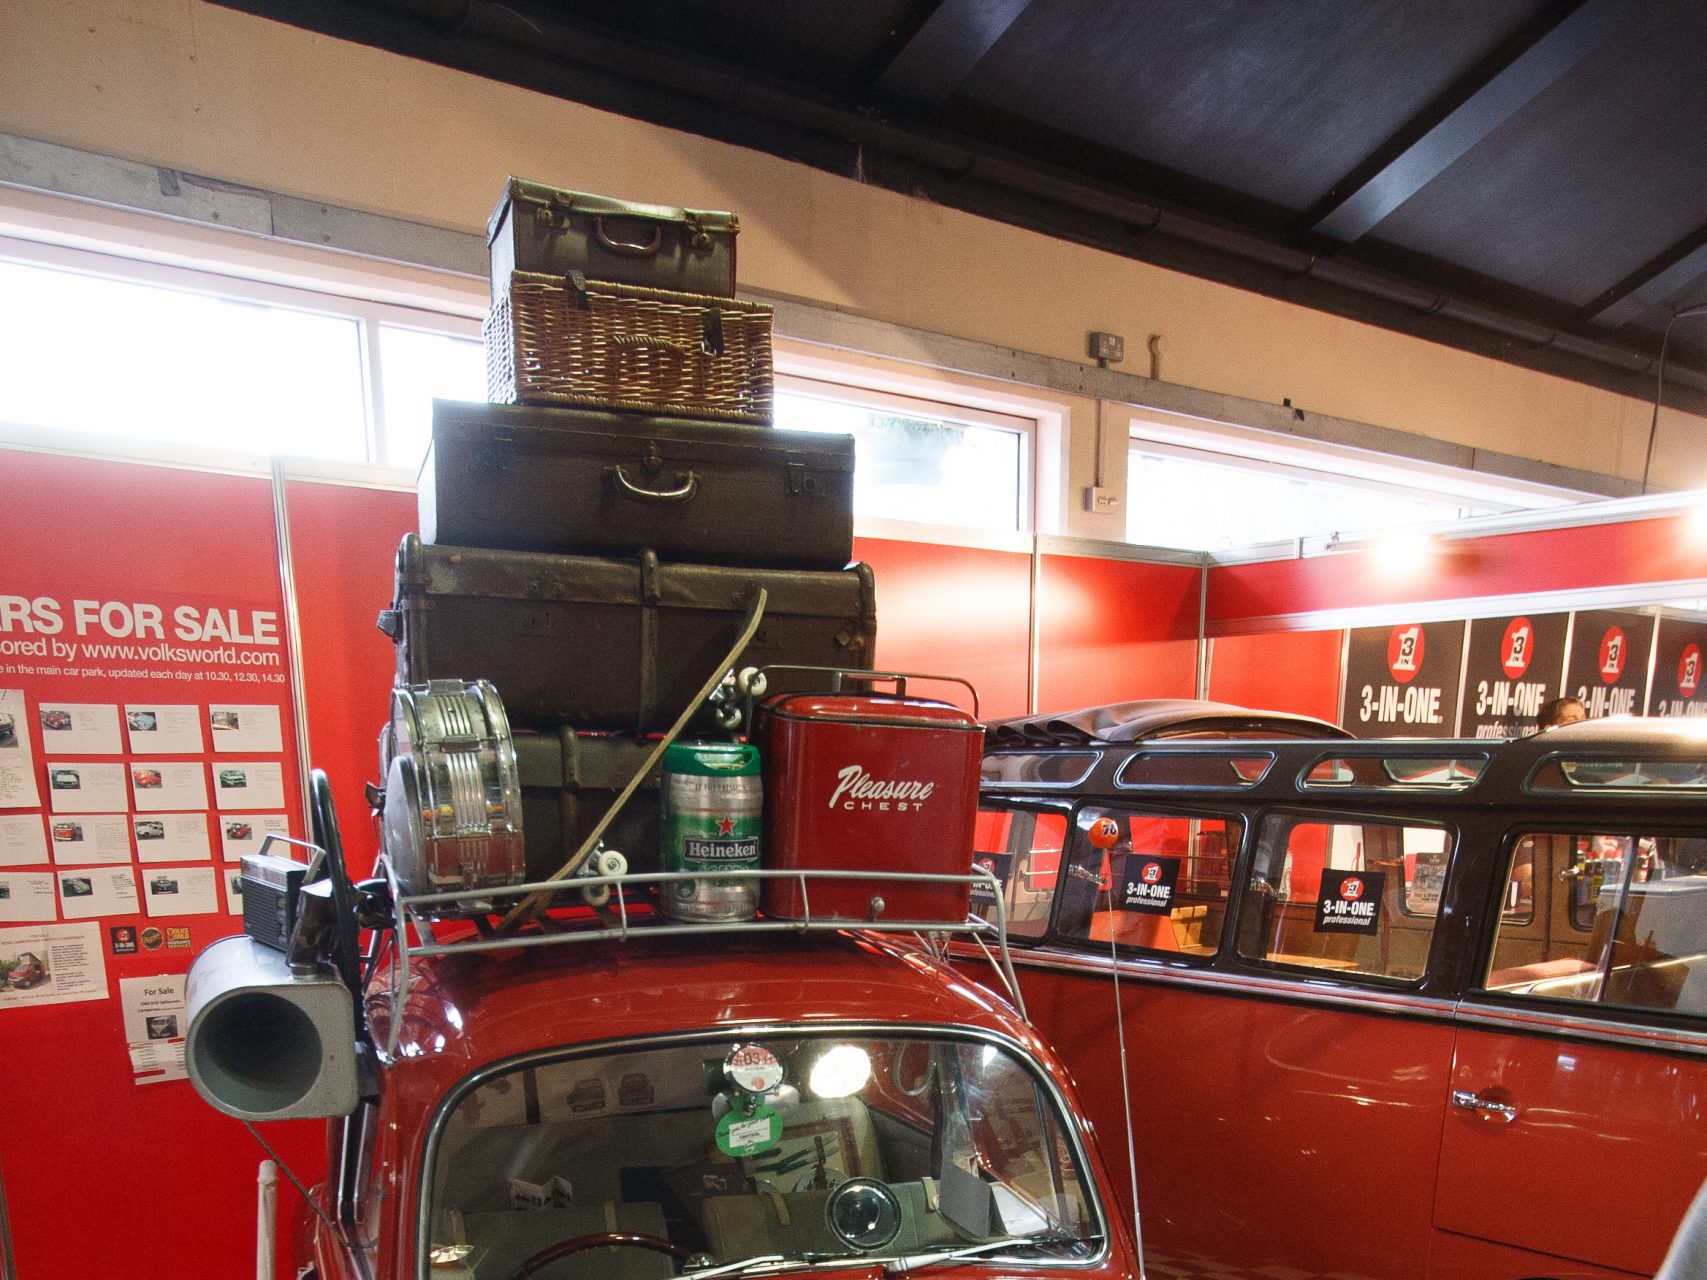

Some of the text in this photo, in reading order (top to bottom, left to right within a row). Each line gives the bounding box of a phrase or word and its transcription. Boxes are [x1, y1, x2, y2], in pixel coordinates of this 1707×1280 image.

[0, 595, 279, 645] RS FOR SALE
[0, 638, 280, 666] ored by www.volksworld.com
[6, 664, 16, 674] in
[18, 665, 34, 674] the
[36, 666, 61, 675] main
[64, 667, 80, 676] car
[82, 668, 106, 678] park,
[108, 669, 148, 678] updated
[150, 670, 174, 679] each
[175, 670, 192, 682] day
[195, 672, 203, 680] at
[262, 674, 285, 683] 14.30
[1360, 684, 1441, 724] 3-IN-ONE
[829, 765, 934, 808] Pleasure
[844, 802, 922, 811] CHEST
[689, 842, 756, 858] Heineken
[1126, 882, 1170, 898] 3-IN-ONE
[1126, 896, 1167, 907] professional
[1323, 900, 1374, 916] 3-IN-ONE
[1322, 914, 1371, 926] professional
[158, 987, 174, 995] Sale
